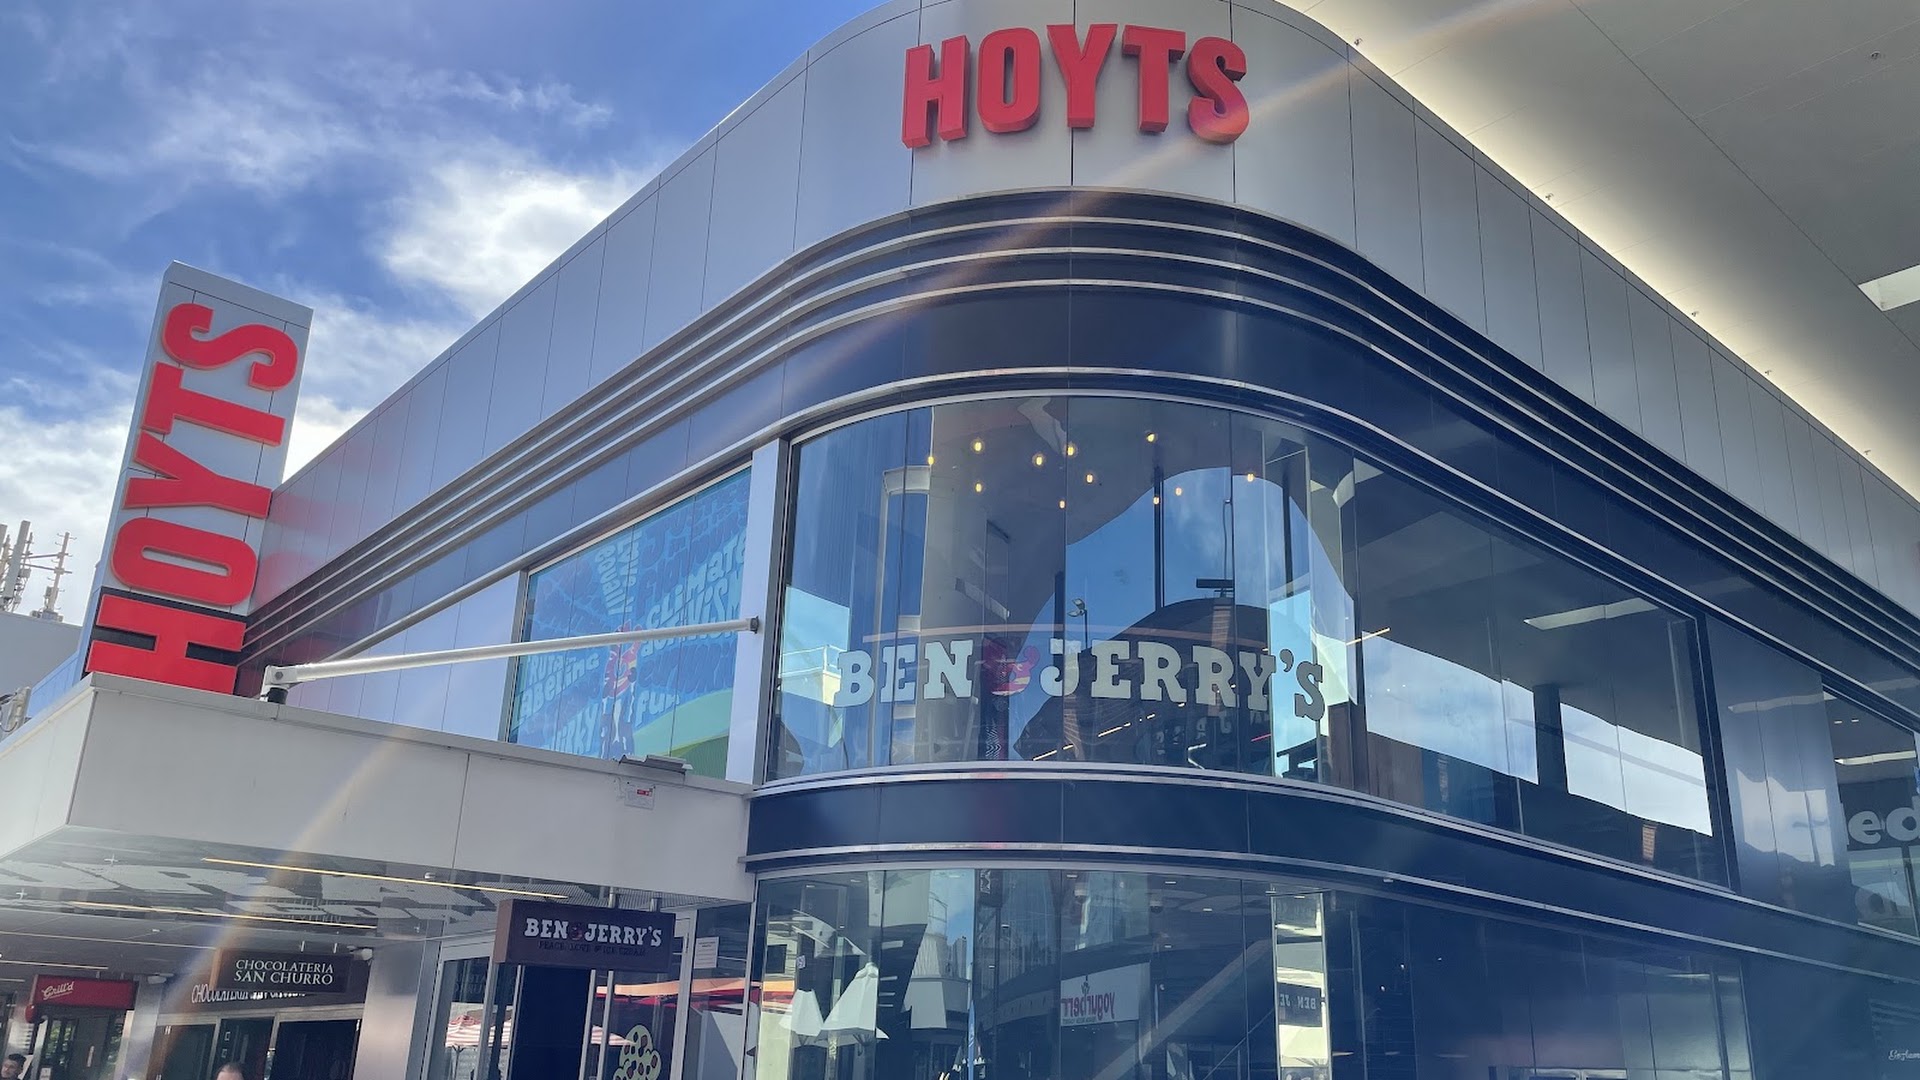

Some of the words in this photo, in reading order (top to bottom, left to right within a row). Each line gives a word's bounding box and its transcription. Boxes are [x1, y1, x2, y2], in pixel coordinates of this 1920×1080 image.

[902, 23, 1250, 149] HOYTS
[86, 302, 299, 695] HOYTS
[834, 639, 973, 708] BEN
[1039, 638, 1326, 722] JERRY'S
[524, 918, 569, 939] BEN
[584, 923, 662, 947] JERRY'S
[234, 970, 266, 983] SAN
[270, 972, 333, 985] CHURRO
[236, 959, 334, 974] CHOCOLATERIA
